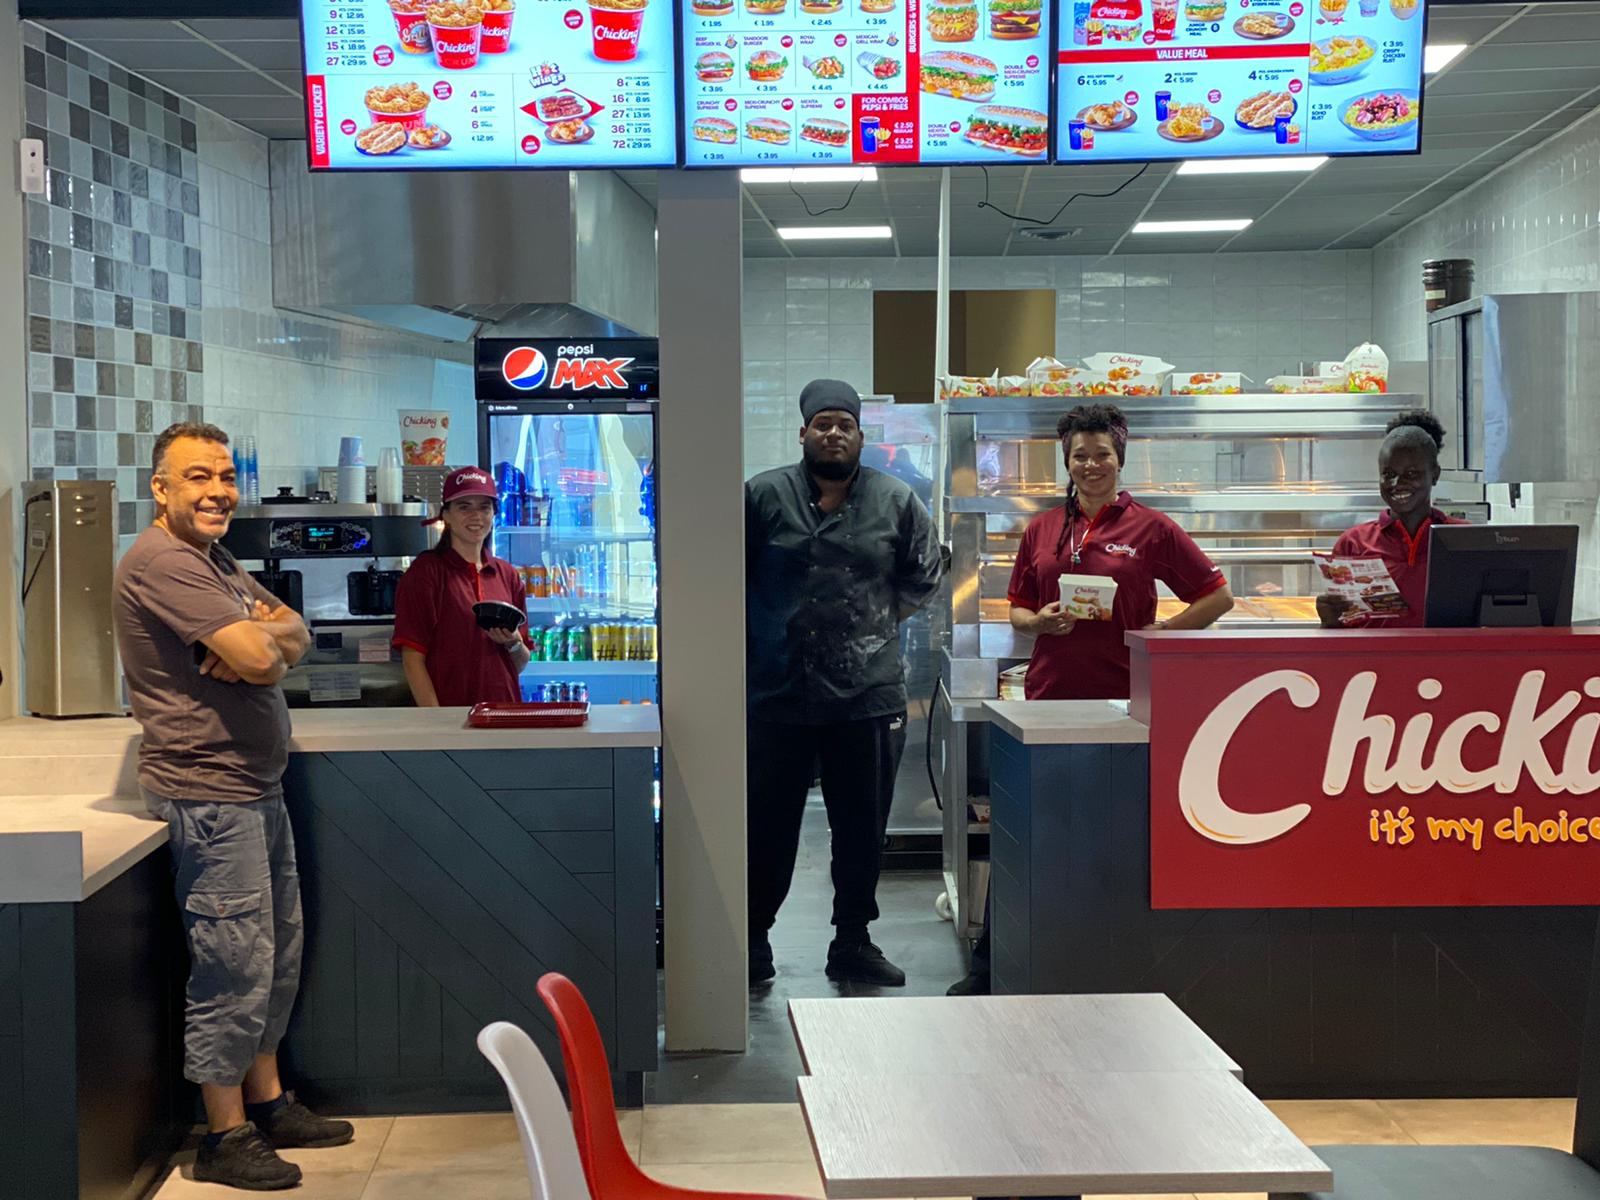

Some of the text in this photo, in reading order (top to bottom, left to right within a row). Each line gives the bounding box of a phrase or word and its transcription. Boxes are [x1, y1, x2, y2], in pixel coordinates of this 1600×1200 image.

[330, 10, 338, 19] 9
[326, 26, 338, 35] 12
[594, 25, 639, 45] Chicking
[908, 19, 917, 53] BURGERS
[327, 41, 339, 50] 15
[436, 40, 477, 55] Chicking
[1157, 48, 1208, 59] VALUE MEAL
[326, 57, 340, 66] 27
[529, 73, 566, 89] Wings
[1077, 75, 1086, 86] 6
[1164, 73, 1173, 83] 2
[1248, 71, 1257, 81] 4
[617, 79, 625, 88] 8
[471, 90, 478, 98] 4
[612, 95, 625, 104] 16
[877, 96, 908, 104] COMBOS
[471, 105, 479, 113] 4
[861, 103, 881, 111] PEPSI
[881, 103, 889, 111] &
[311, 83, 327, 155] VARIETY BUCKET
[611, 110, 626, 119] 27
[472, 120, 479, 129] 6
[611, 125, 626, 134] 36
[900, 121, 914, 129] 2.50
[612, 140, 626, 149] 72
[632, 141, 651, 149] 29.95
[557, 343, 594, 357] pepsi
[1109, 355, 1144, 367] Chicking
[549, 357, 636, 391] MAX
[403, 415, 437, 429] Chicking
[456, 472, 487, 485] Chicking
[1104, 543, 1137, 557] Chicking
[1369, 805, 1415, 846] it's
[1426, 815, 1484, 851] my
